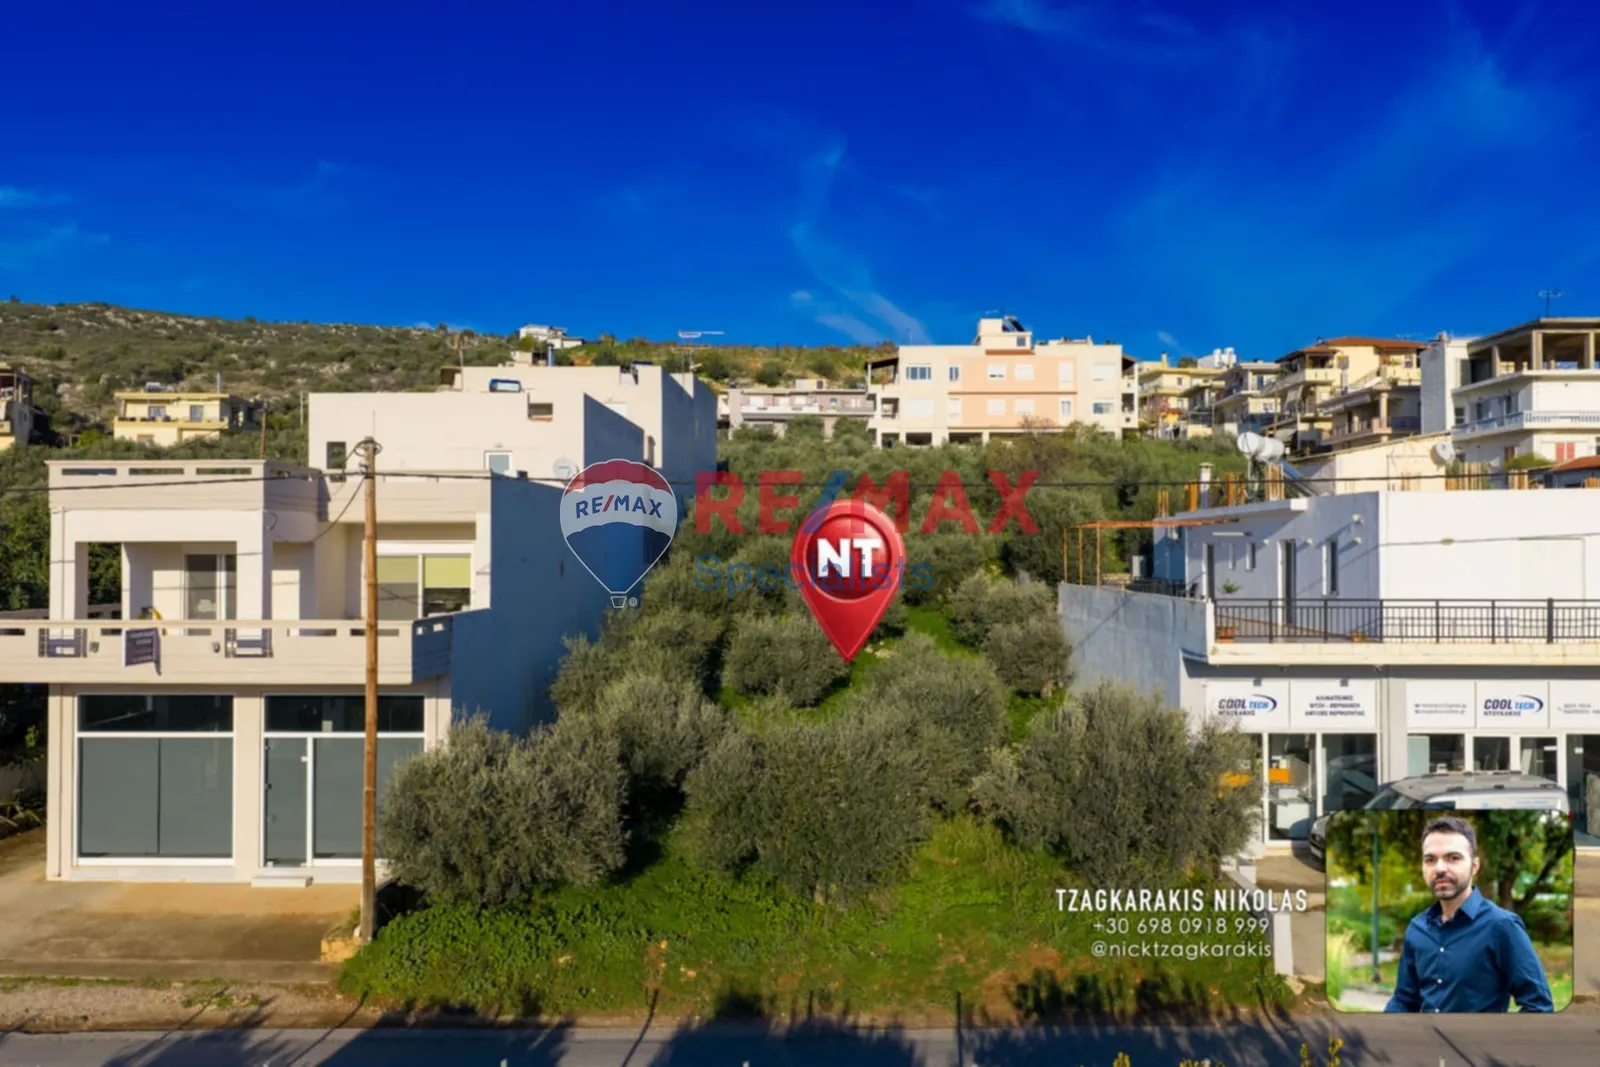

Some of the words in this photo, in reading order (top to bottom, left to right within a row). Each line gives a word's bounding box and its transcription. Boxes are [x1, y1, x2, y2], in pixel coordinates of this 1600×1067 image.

[1218, 699, 1246, 709] COOL
[1249, 701, 1269, 709] TECH
[1484, 699, 1512, 709] COOL
[1515, 702, 1535, 710] TECH
